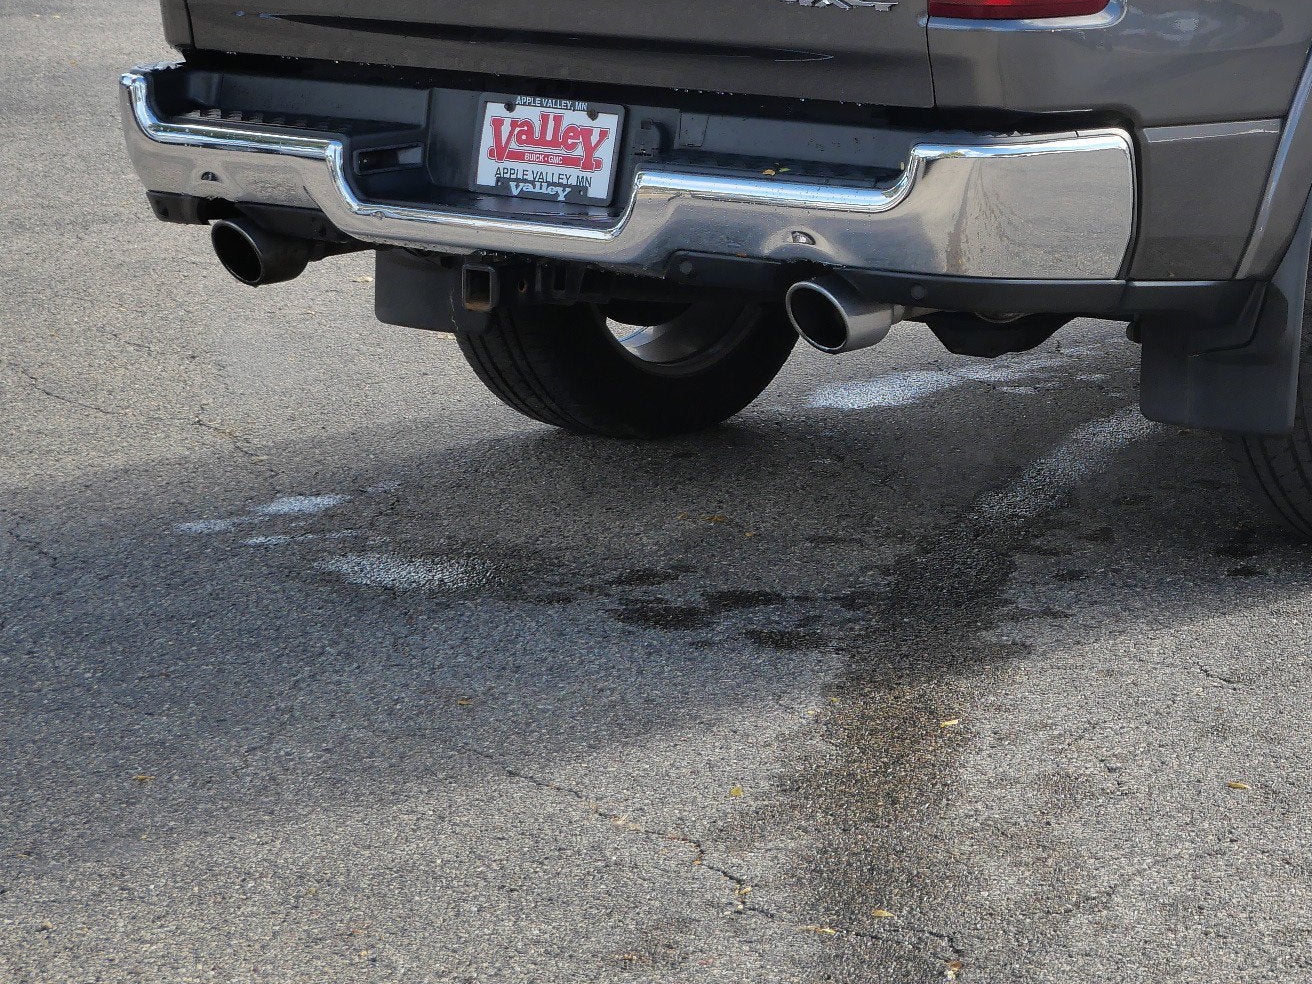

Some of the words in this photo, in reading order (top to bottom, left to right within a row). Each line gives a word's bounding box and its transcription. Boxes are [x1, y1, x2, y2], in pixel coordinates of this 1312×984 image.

[515, 95, 542, 107] APPLE
[542, 98, 574, 112] VALLEY,
[575, 101, 588, 111] MN
[490, 111, 611, 173] Valley
[524, 152, 545, 163] BUICK
[548, 155, 563, 165] GMC
[494, 166, 532, 180] APPLE
[576, 175, 593, 188] MN
[509, 181, 572, 201] Valley
